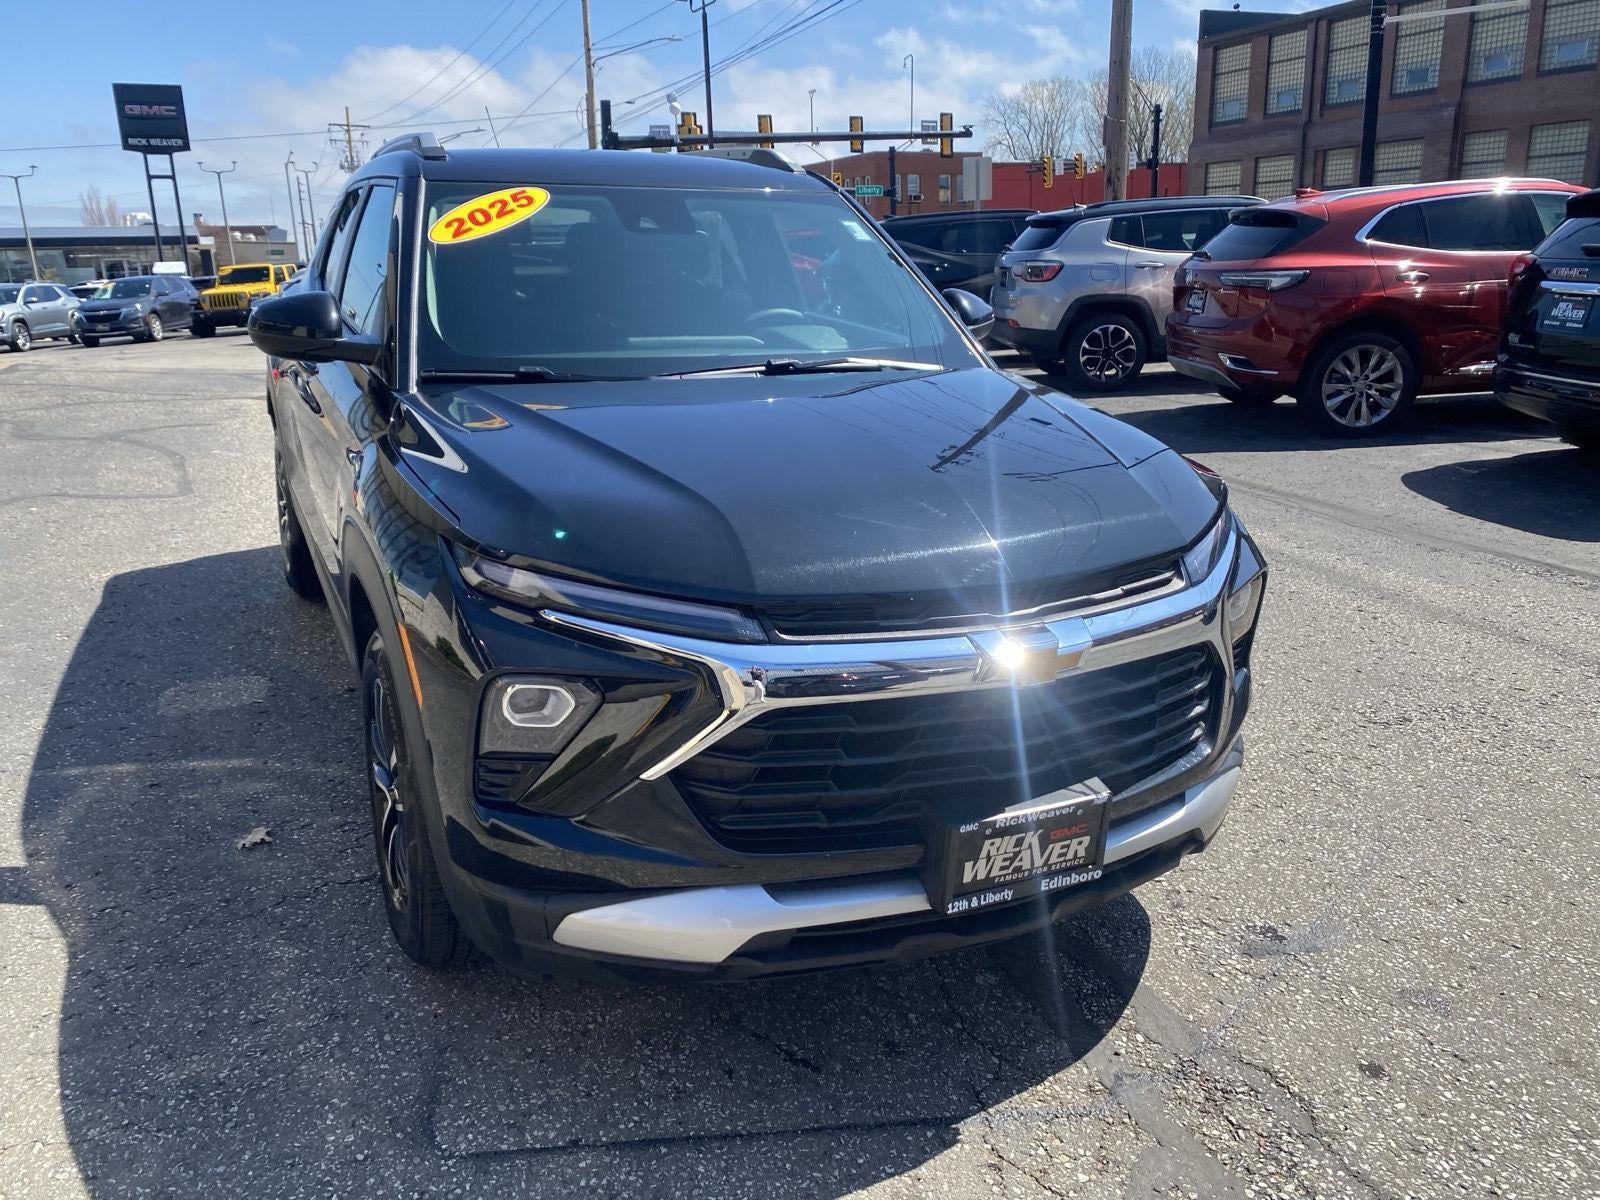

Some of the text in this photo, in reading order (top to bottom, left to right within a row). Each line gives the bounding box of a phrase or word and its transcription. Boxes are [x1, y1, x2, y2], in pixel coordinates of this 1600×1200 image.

[125, 104, 177, 116] GMC
[127, 137, 184, 147] RICK WEAVER
[858, 187, 880, 195] Liberty
[444, 190, 535, 239] 2025
[1552, 267, 1589, 278] GMC
[1551, 308, 1585, 319] WEAVER
[960, 822, 979, 834] GMC
[979, 823, 1088, 859] RICK GMC
[962, 835, 1091, 884] WEAVER
[994, 857, 1085, 884] FAMOUS FOR SERVICE
[1040, 869, 1103, 891] Edinboro
[947, 888, 1014, 914] 12th & Liberty
